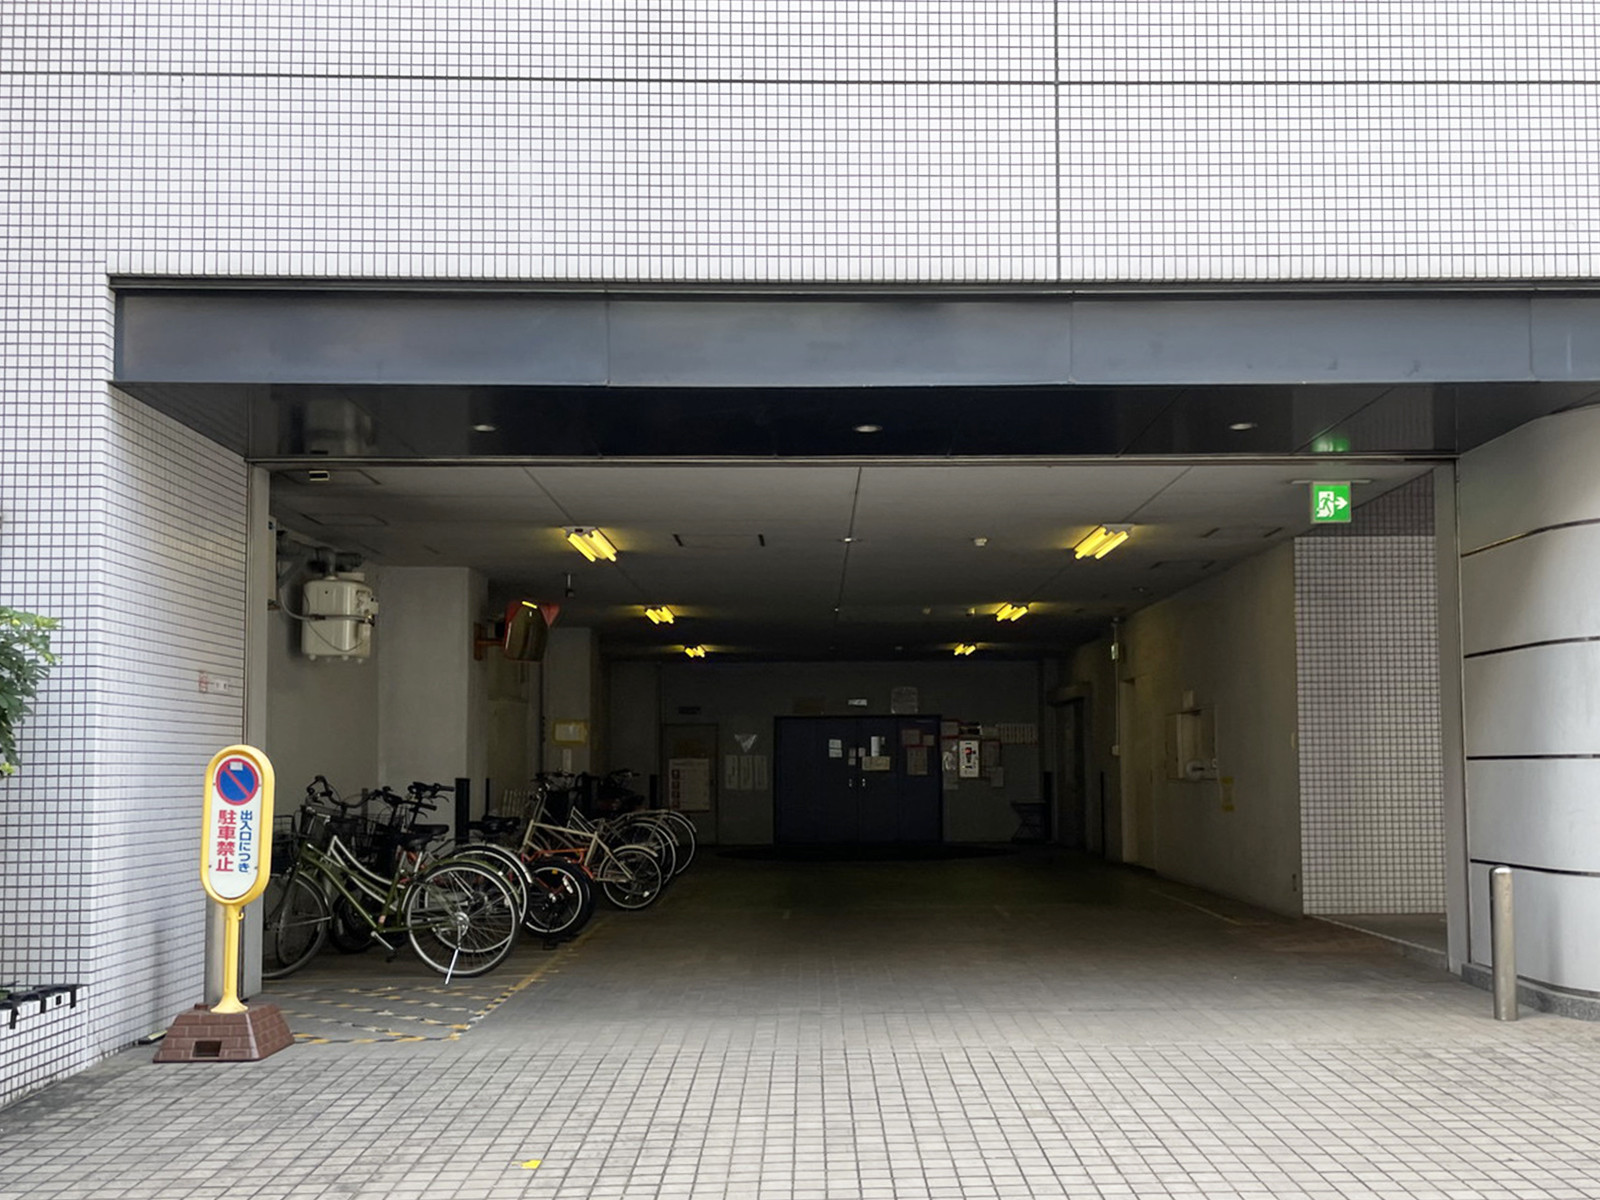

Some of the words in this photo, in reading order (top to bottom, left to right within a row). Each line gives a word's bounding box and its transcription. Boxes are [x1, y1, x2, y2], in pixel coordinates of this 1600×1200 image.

[216, 809, 237, 872] 駐車禁止
[238, 809, 253, 873] 出入口につき
